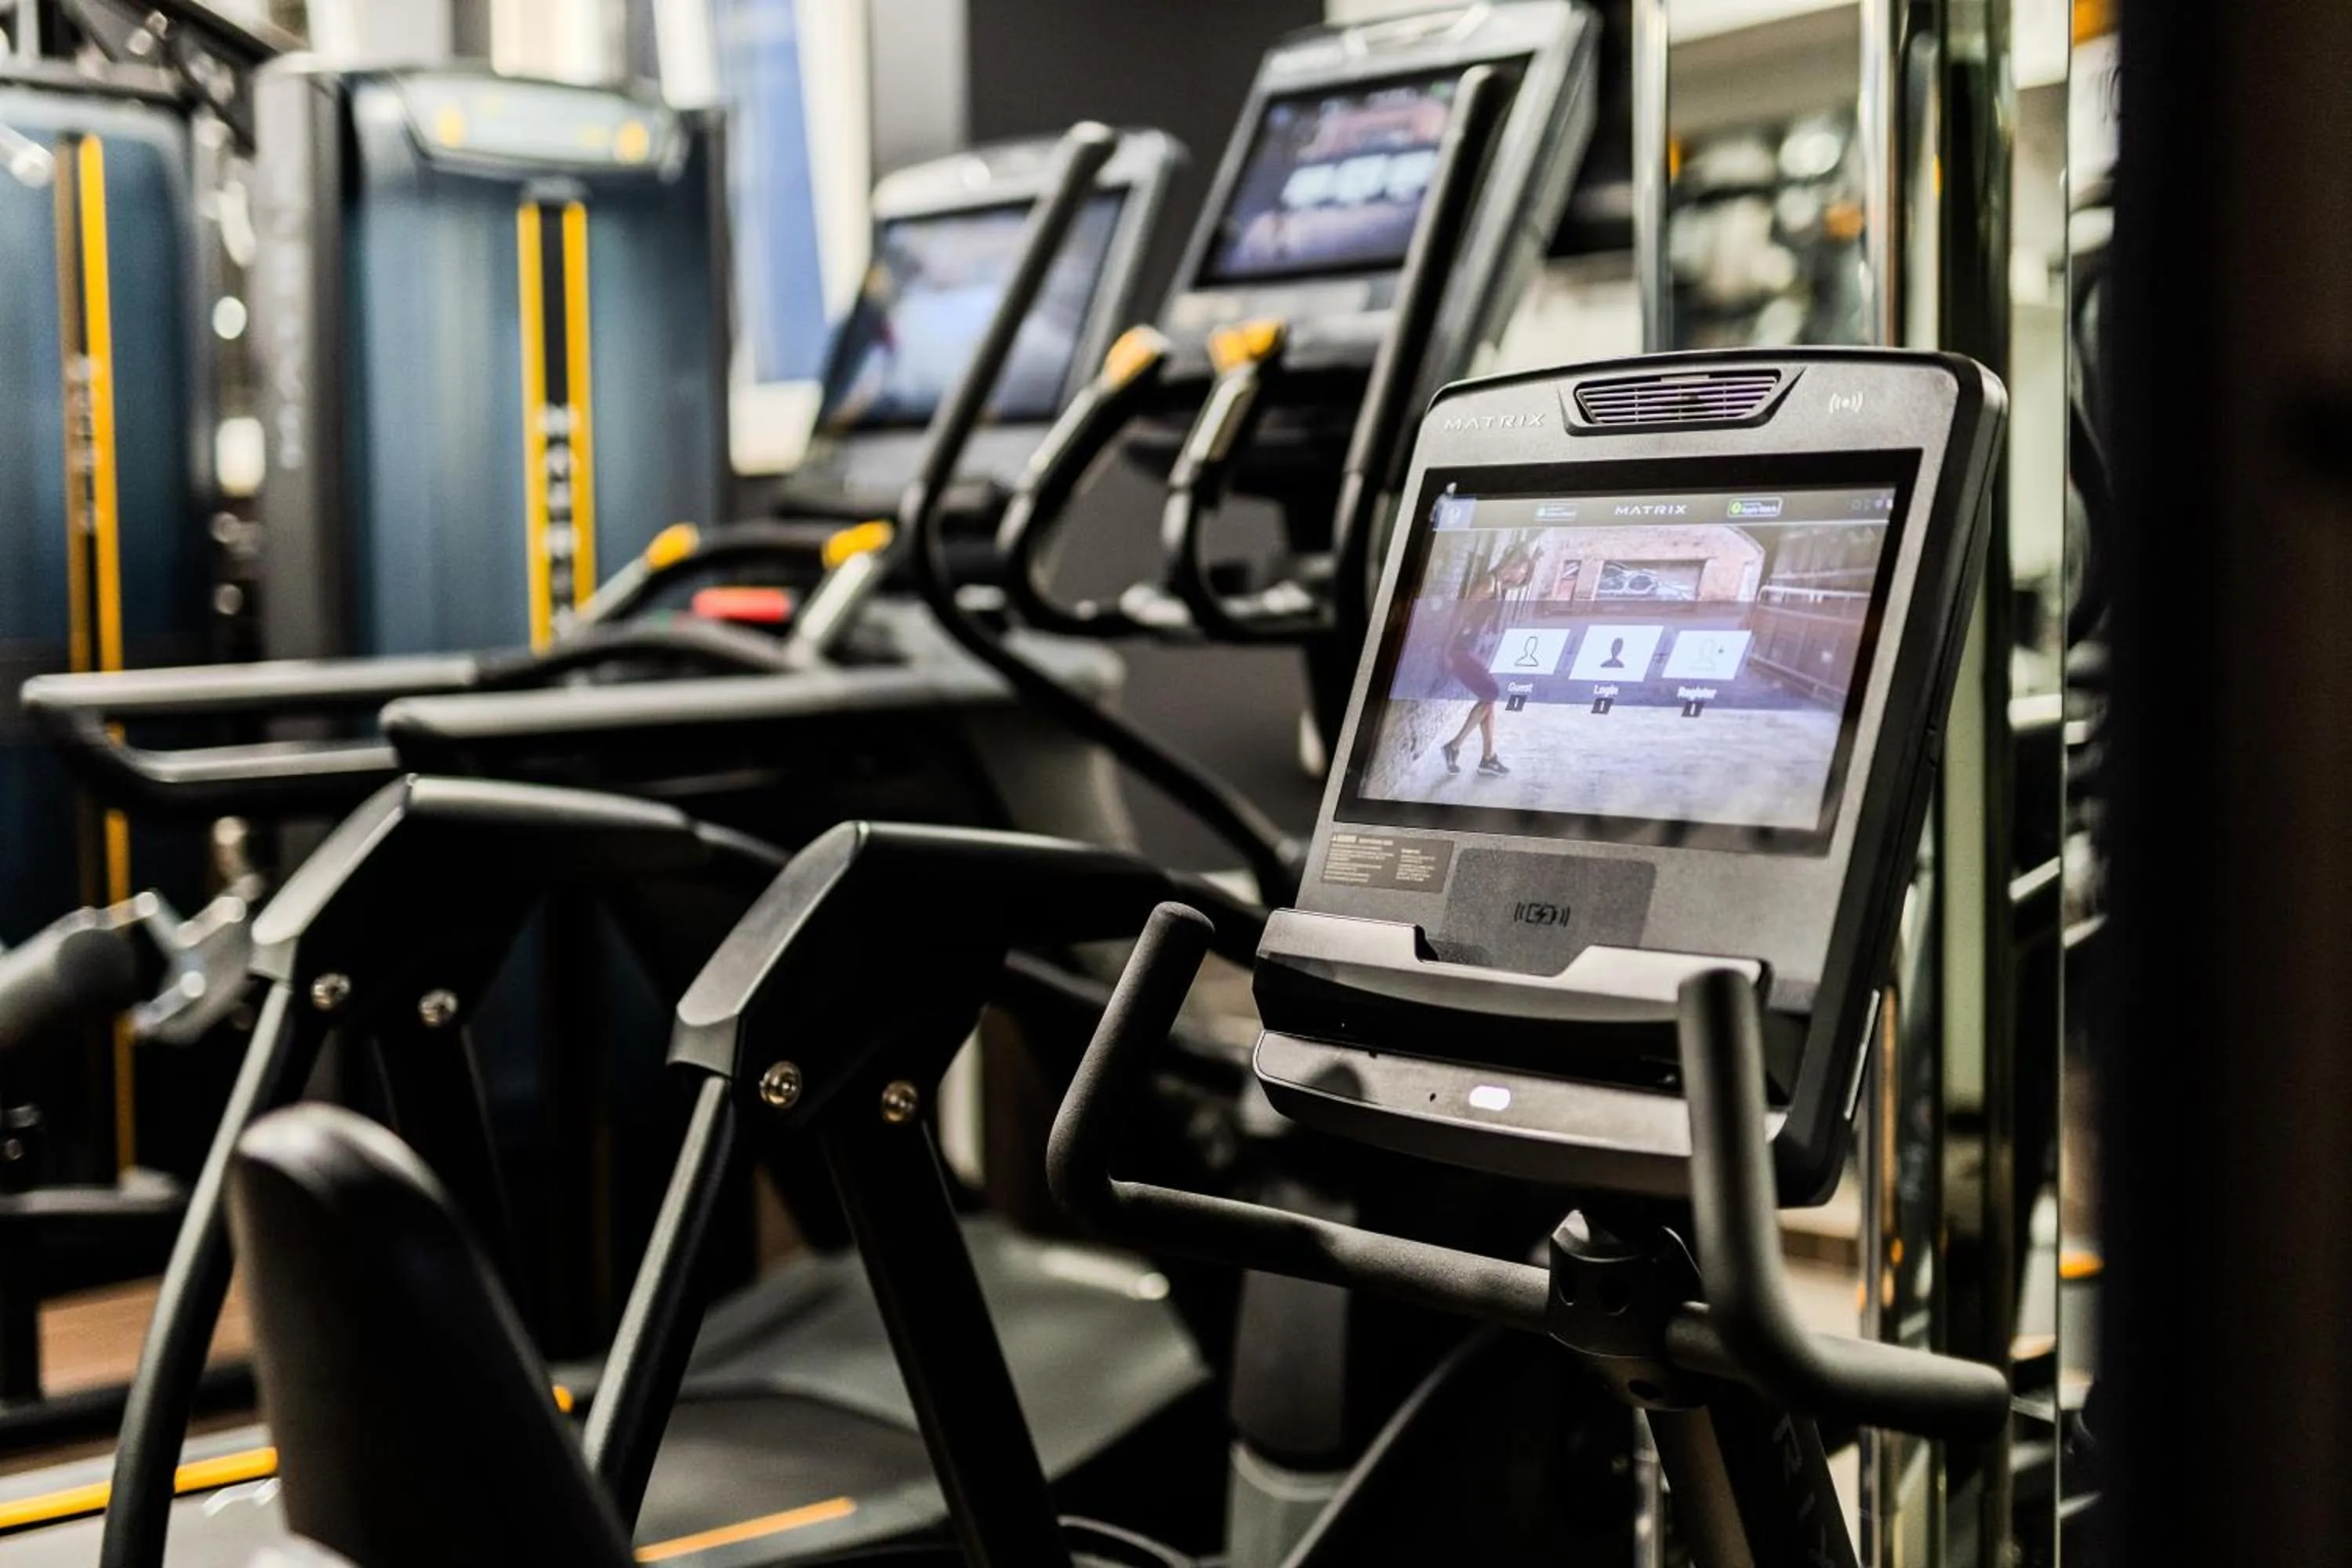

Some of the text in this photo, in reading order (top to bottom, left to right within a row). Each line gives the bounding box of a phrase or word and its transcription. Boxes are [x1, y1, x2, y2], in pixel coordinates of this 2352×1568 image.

[1443, 413, 1545, 430] MATRIX
[1614, 504, 1688, 516] MATRIX
[1593, 684, 1619, 697] Login
